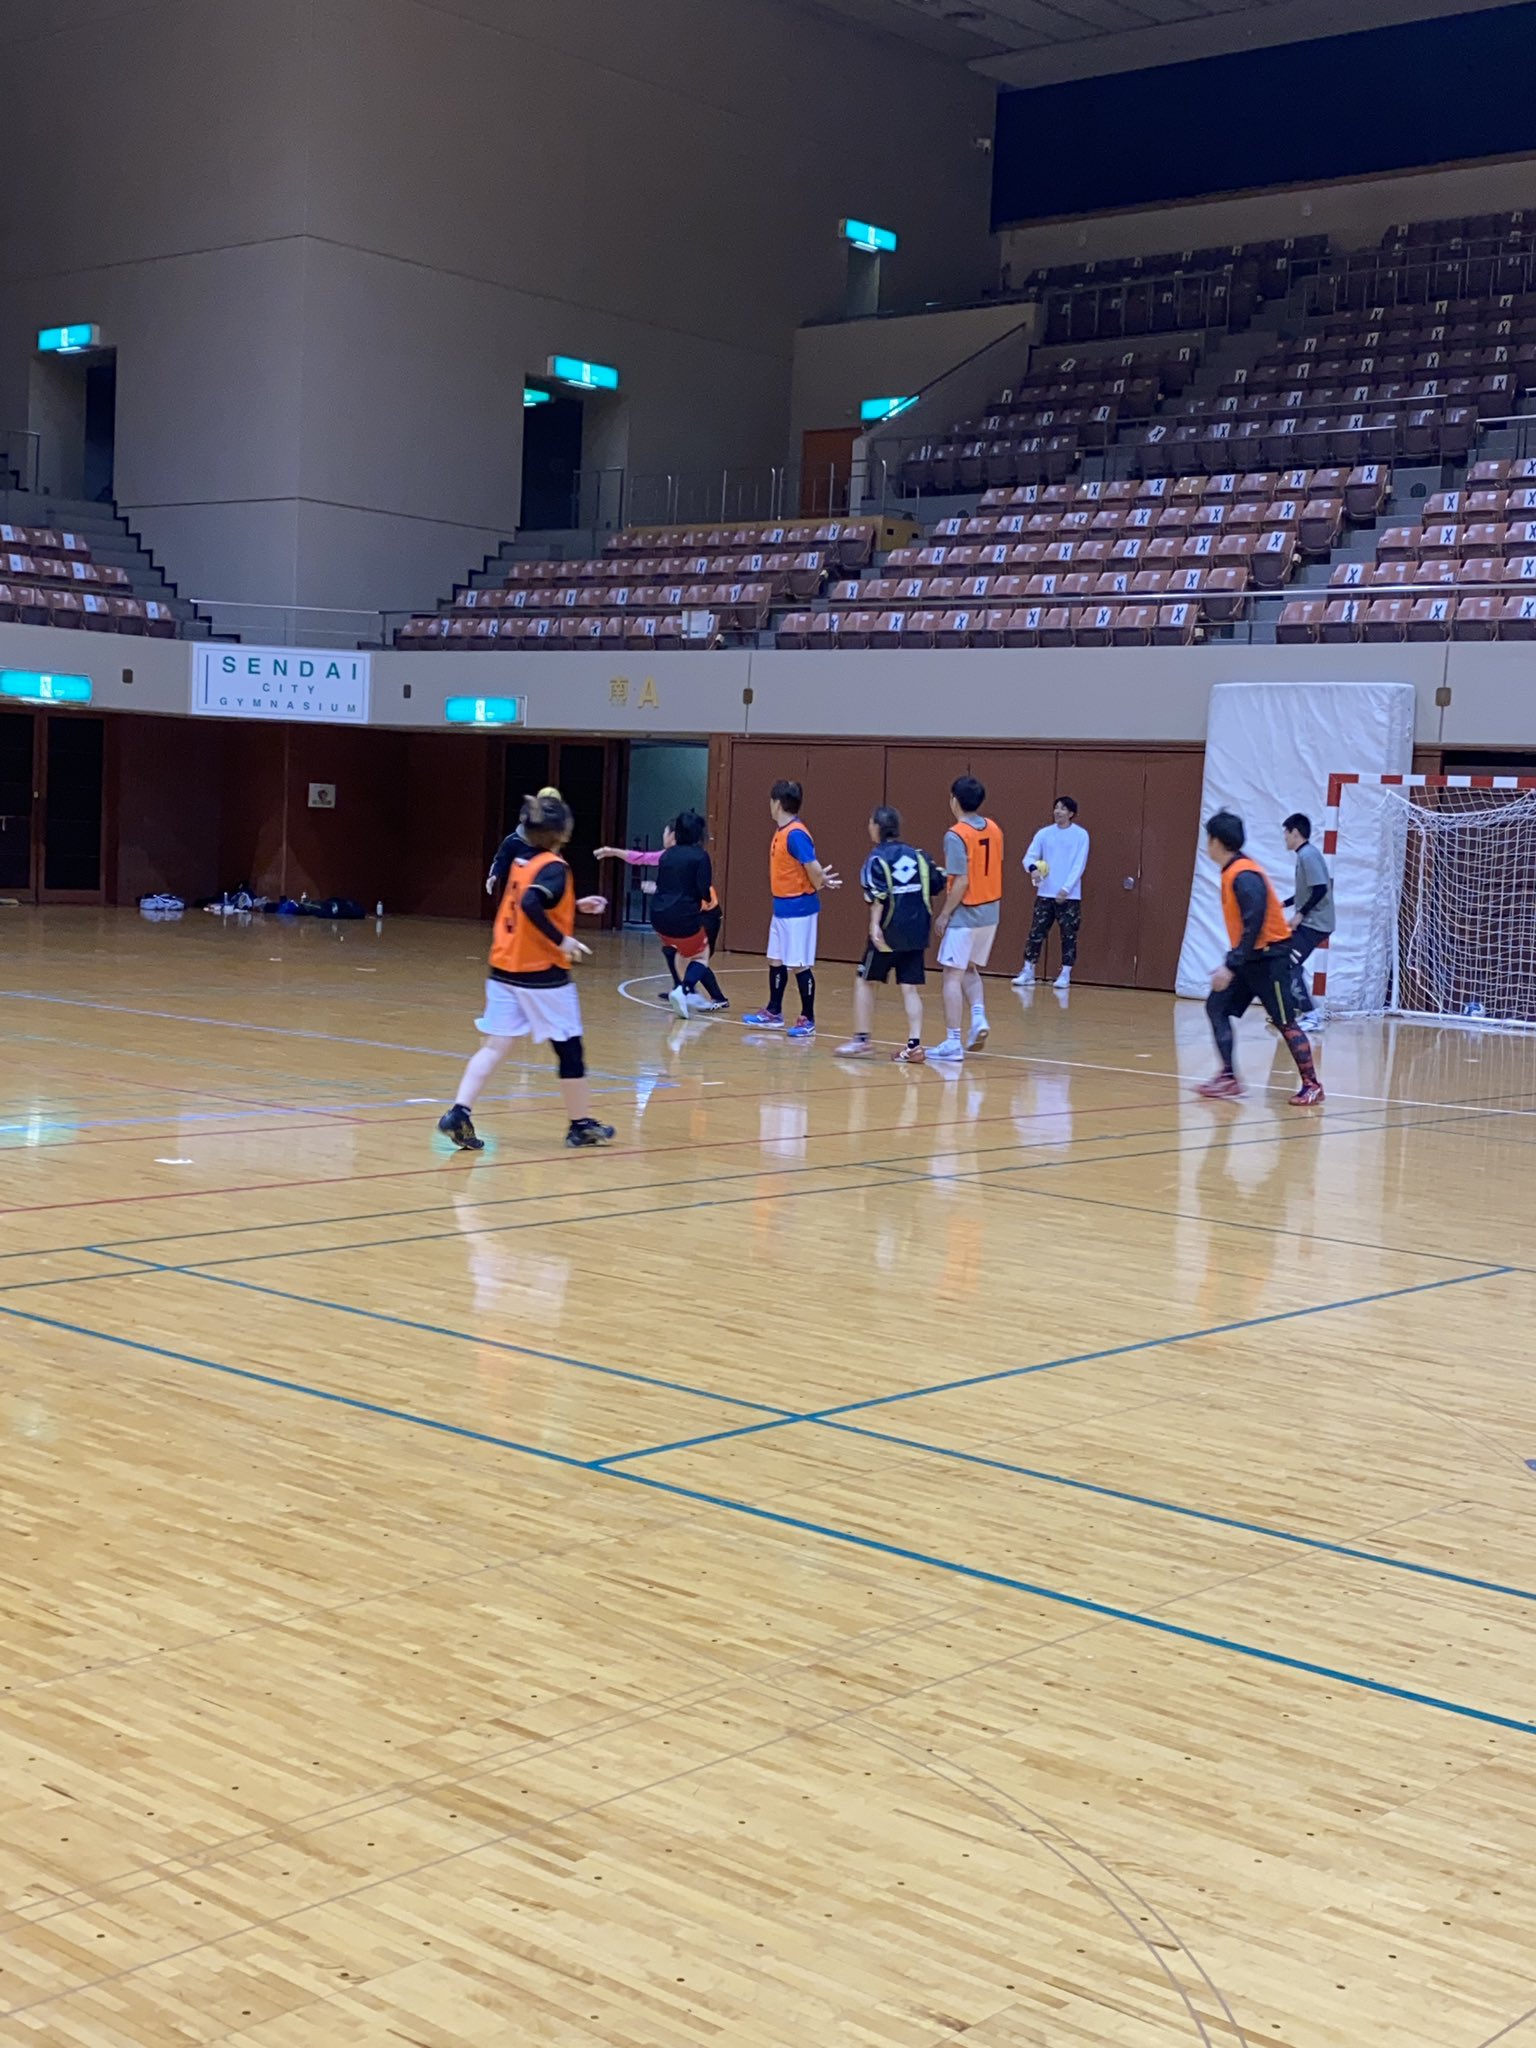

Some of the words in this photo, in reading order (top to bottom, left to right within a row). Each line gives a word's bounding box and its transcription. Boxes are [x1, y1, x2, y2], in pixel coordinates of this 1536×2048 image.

[222, 656, 357, 680] SENDAI
[262, 683, 315, 695] CITY
[219, 697, 356, 713] GYMNASIUM
